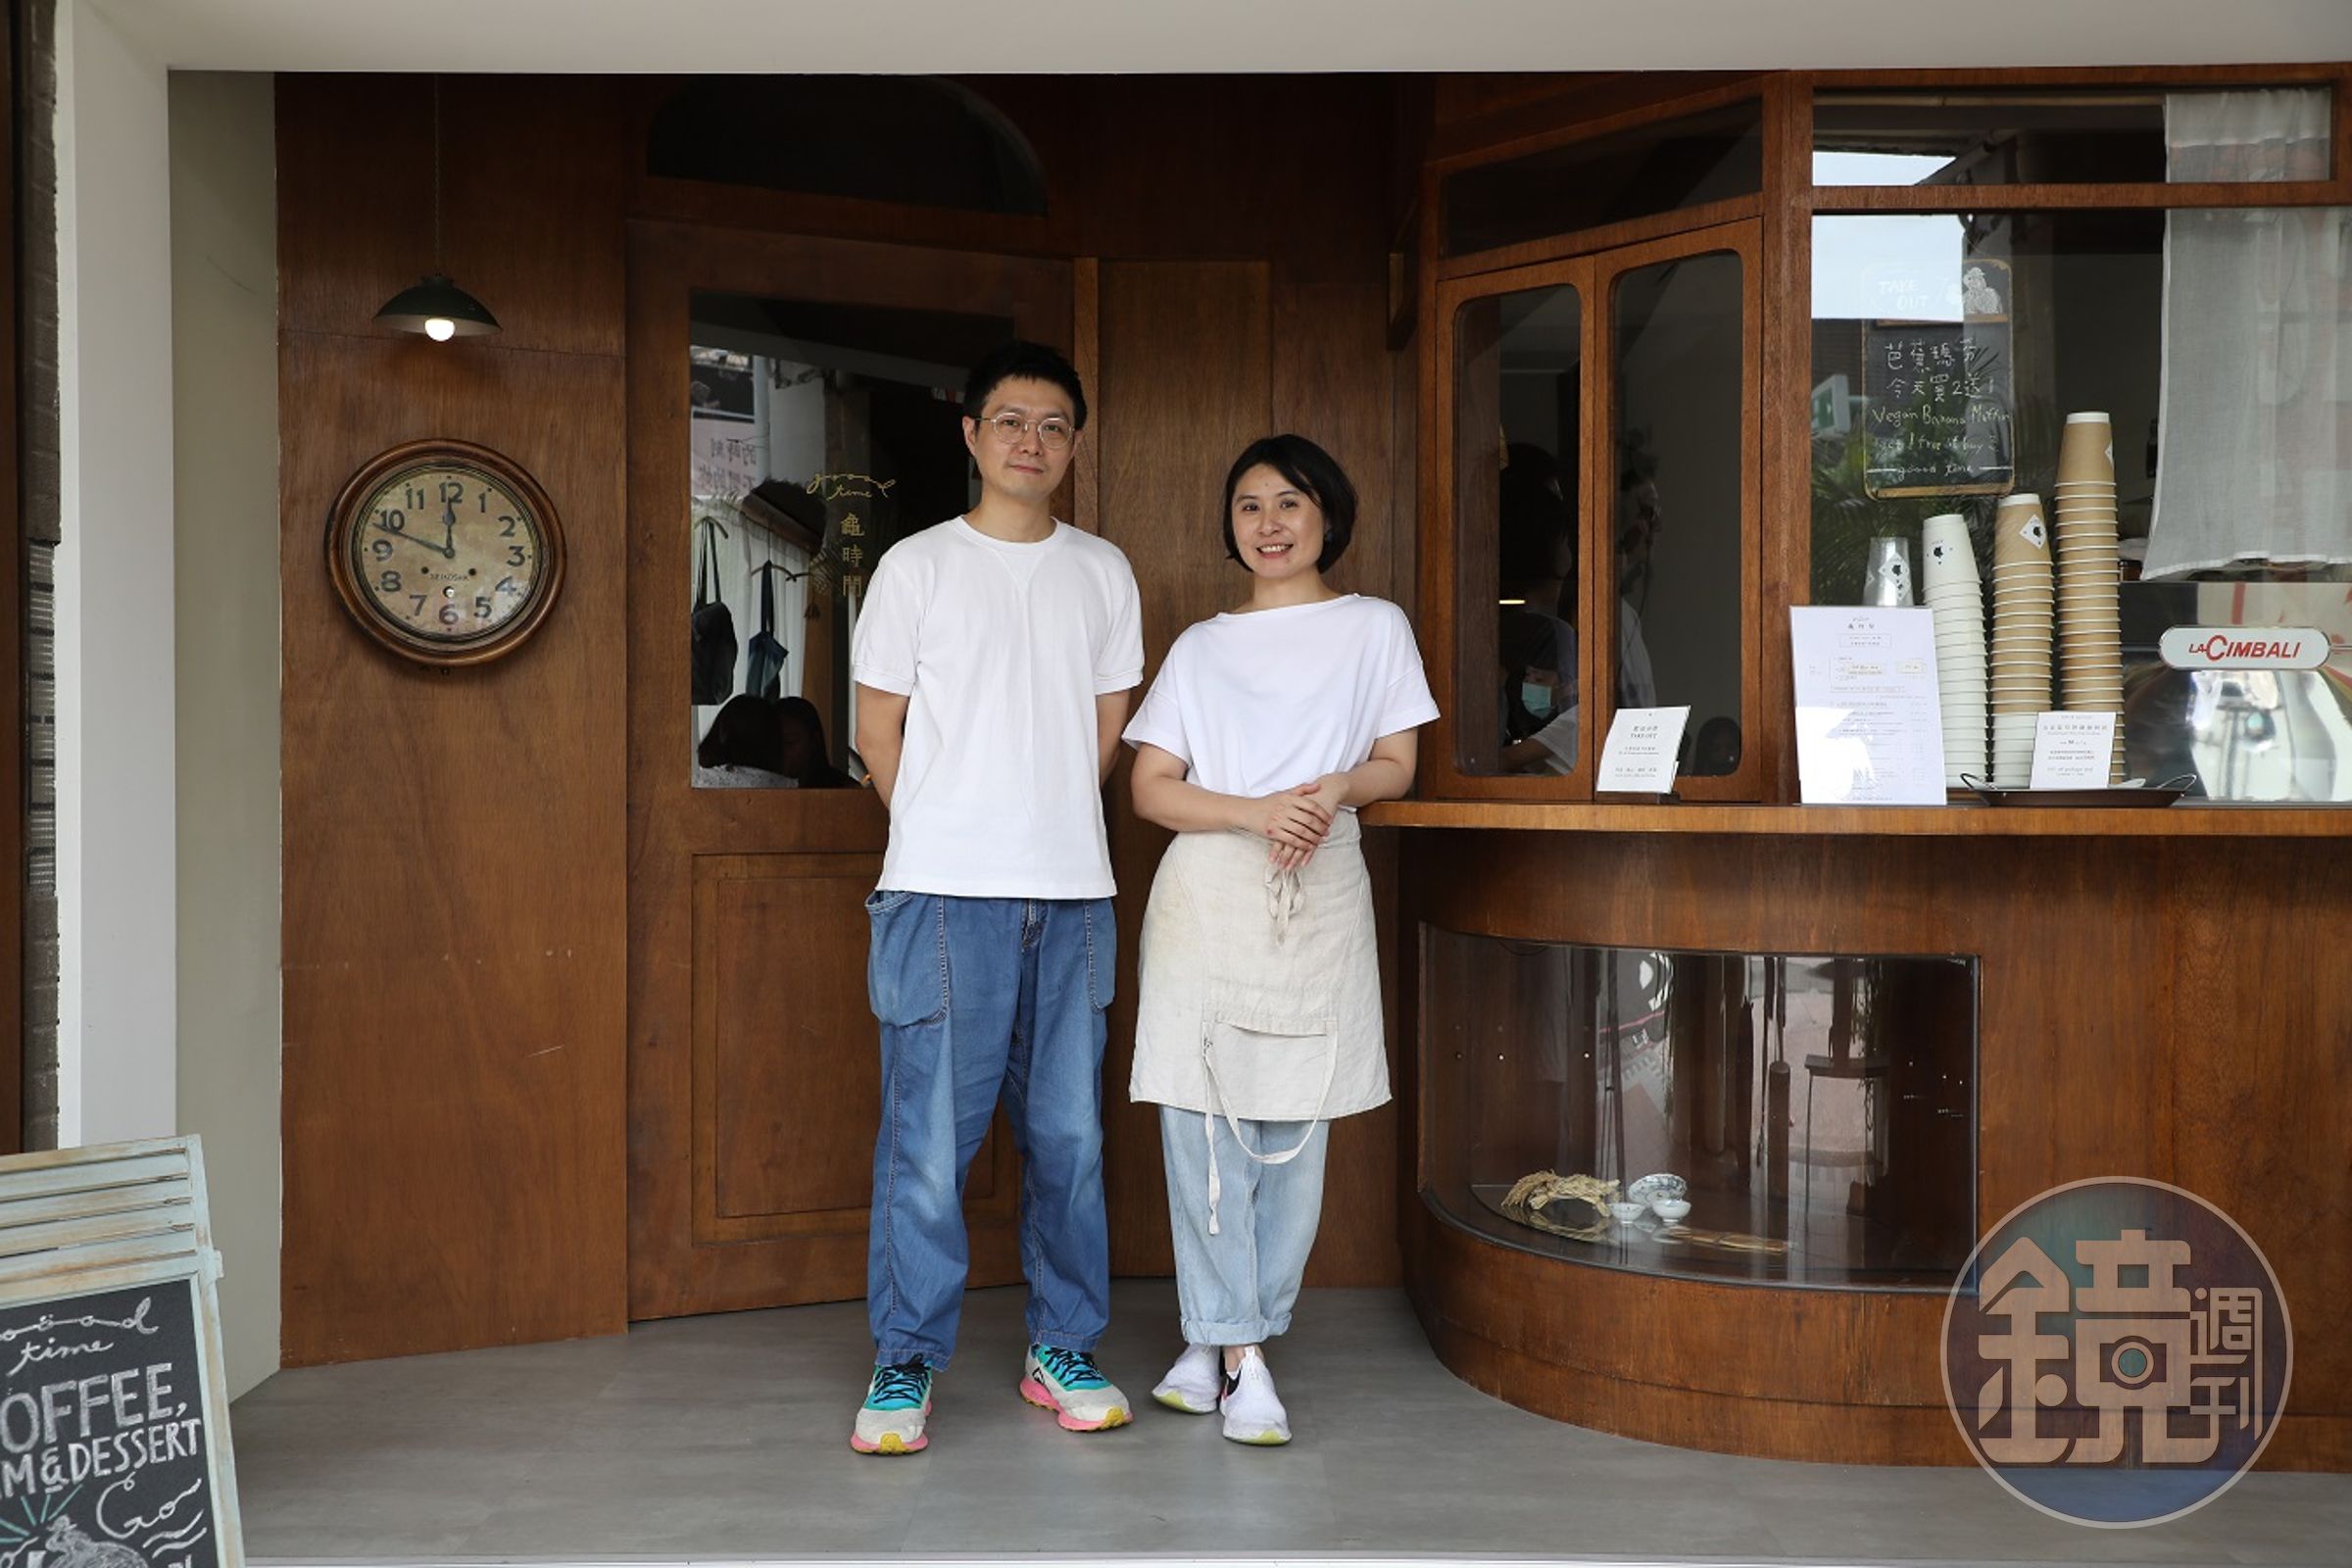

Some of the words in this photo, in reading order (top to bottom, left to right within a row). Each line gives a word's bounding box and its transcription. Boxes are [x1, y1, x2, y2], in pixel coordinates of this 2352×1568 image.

[1872, 406, 1919, 427] Vegan
[405, 488, 424, 510] 11
[438, 481, 464, 504] 12
[478, 493, 486, 514] 1
[379, 509, 405, 532] 10
[498, 515, 515, 537] 2
[371, 540, 393, 562] 9
[507, 545, 526, 567] 3
[841, 513, 864, 597] 龜時間
[380, 569, 402, 593] 8
[495, 575, 517, 594] 4
[409, 594, 427, 616] 7
[439, 604, 460, 625] 6
[473, 596, 492, 618] 5
[2206, 634, 2302, 662] CIMBALI
[6, 1337, 115, 1377] time
